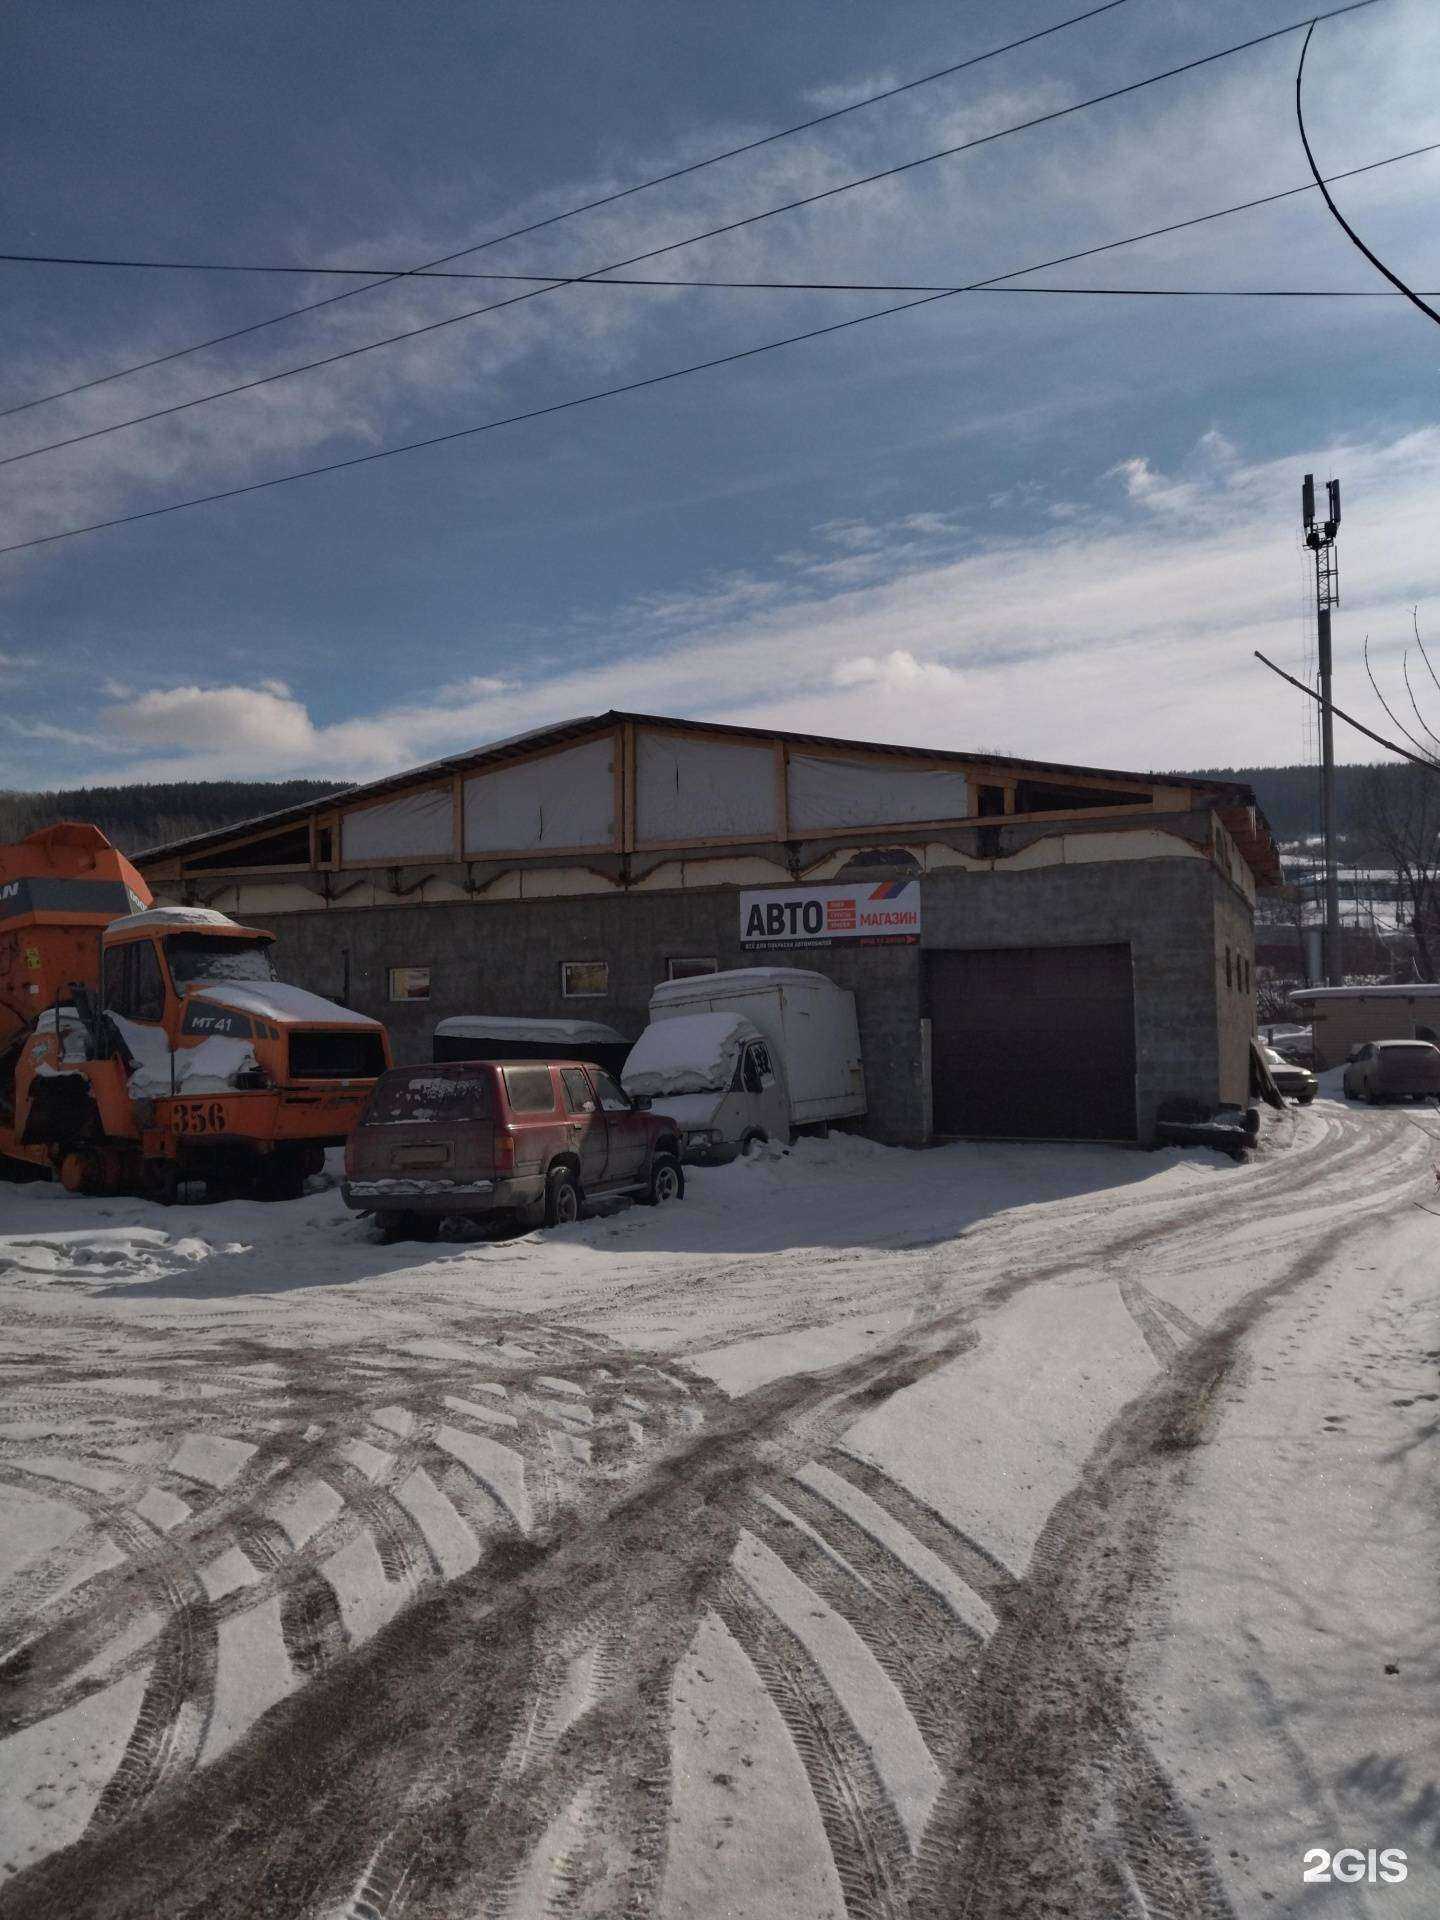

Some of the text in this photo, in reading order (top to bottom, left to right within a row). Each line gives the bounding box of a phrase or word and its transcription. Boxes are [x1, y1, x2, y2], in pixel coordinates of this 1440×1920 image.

[0, 883, 19, 899] N
[746, 901, 823, 936] АВТО
[860, 911, 917, 926] МАГАЗИН
[191, 1017, 232, 1032] MT 41
[173, 1103, 226, 1133] 356
